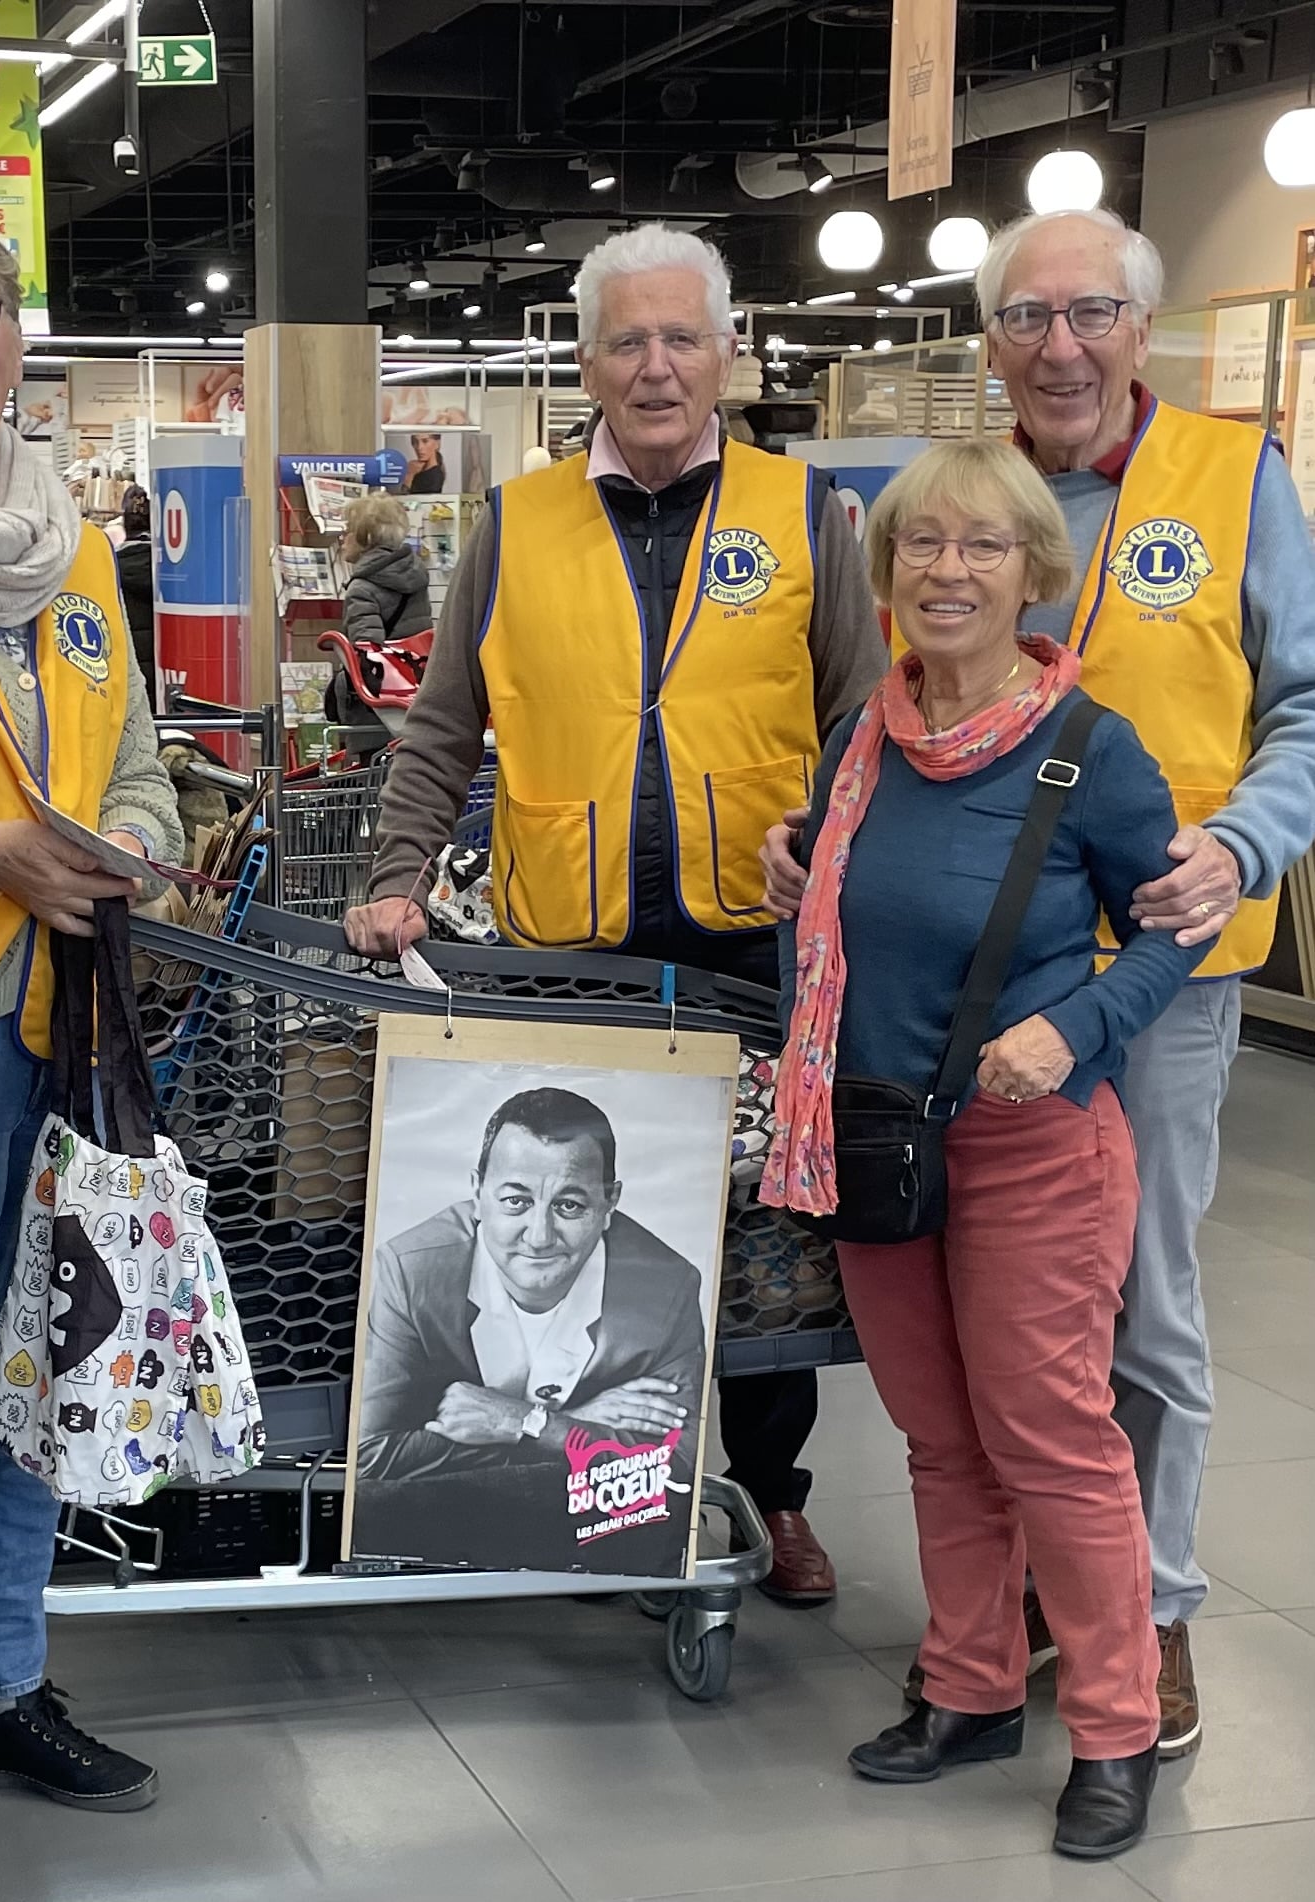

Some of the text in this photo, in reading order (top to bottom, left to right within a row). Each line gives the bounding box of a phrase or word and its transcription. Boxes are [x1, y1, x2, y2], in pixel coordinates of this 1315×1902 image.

[167, 508, 182, 548] U
[709, 530, 756, 550] LIONS
[1132, 522, 1192, 542] LIONS
[723, 551, 749, 580] L
[1148, 546, 1176, 578] L
[712, 583, 764, 600] INTERNATIONAL
[1129, 584, 1190, 602] INTERNATIONAL
[53, 596, 100, 617] LIONS
[73, 617, 98, 652] L
[566, 1444, 672, 1493] LES RESTAURANTS
[567, 1488, 594, 1514] DU
[576, 1524, 593, 1540] LES
[593, 1516, 624, 1536] RELAIS
[624, 1513, 637, 1526] DU
